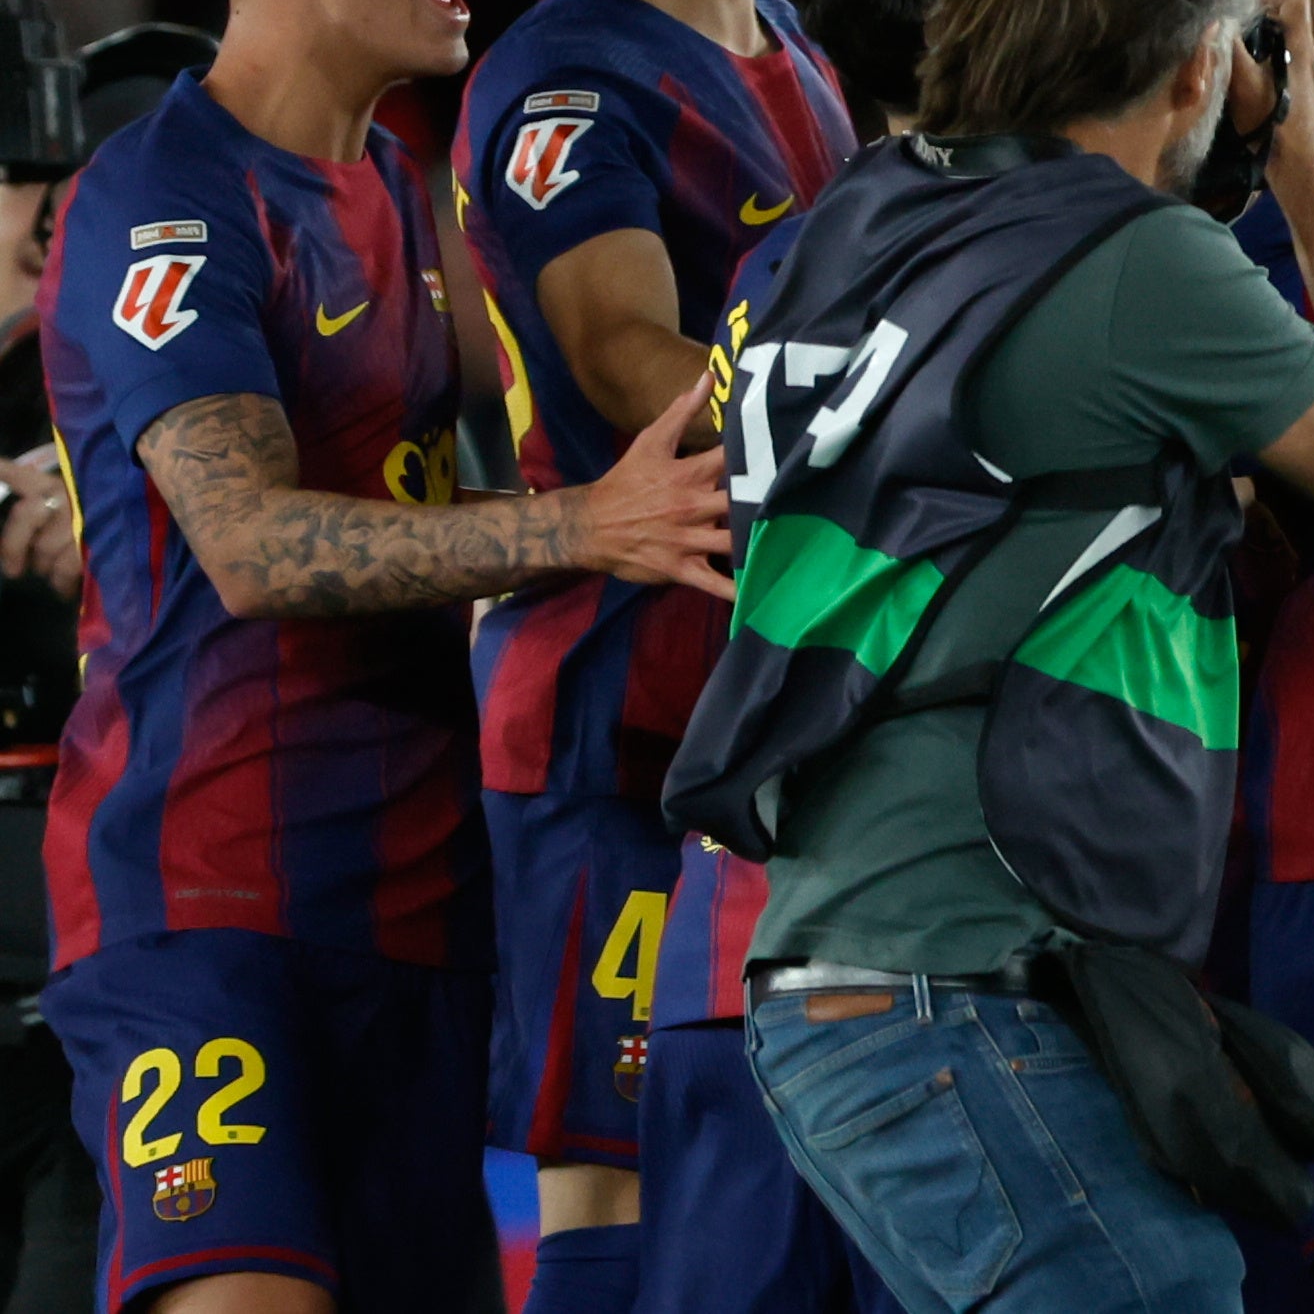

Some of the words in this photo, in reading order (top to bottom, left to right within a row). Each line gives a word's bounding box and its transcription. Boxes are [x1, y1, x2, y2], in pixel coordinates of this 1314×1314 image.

[729, 318, 909, 505] 17
[591, 889, 669, 1022] 4
[121, 1037, 268, 1169] 22
